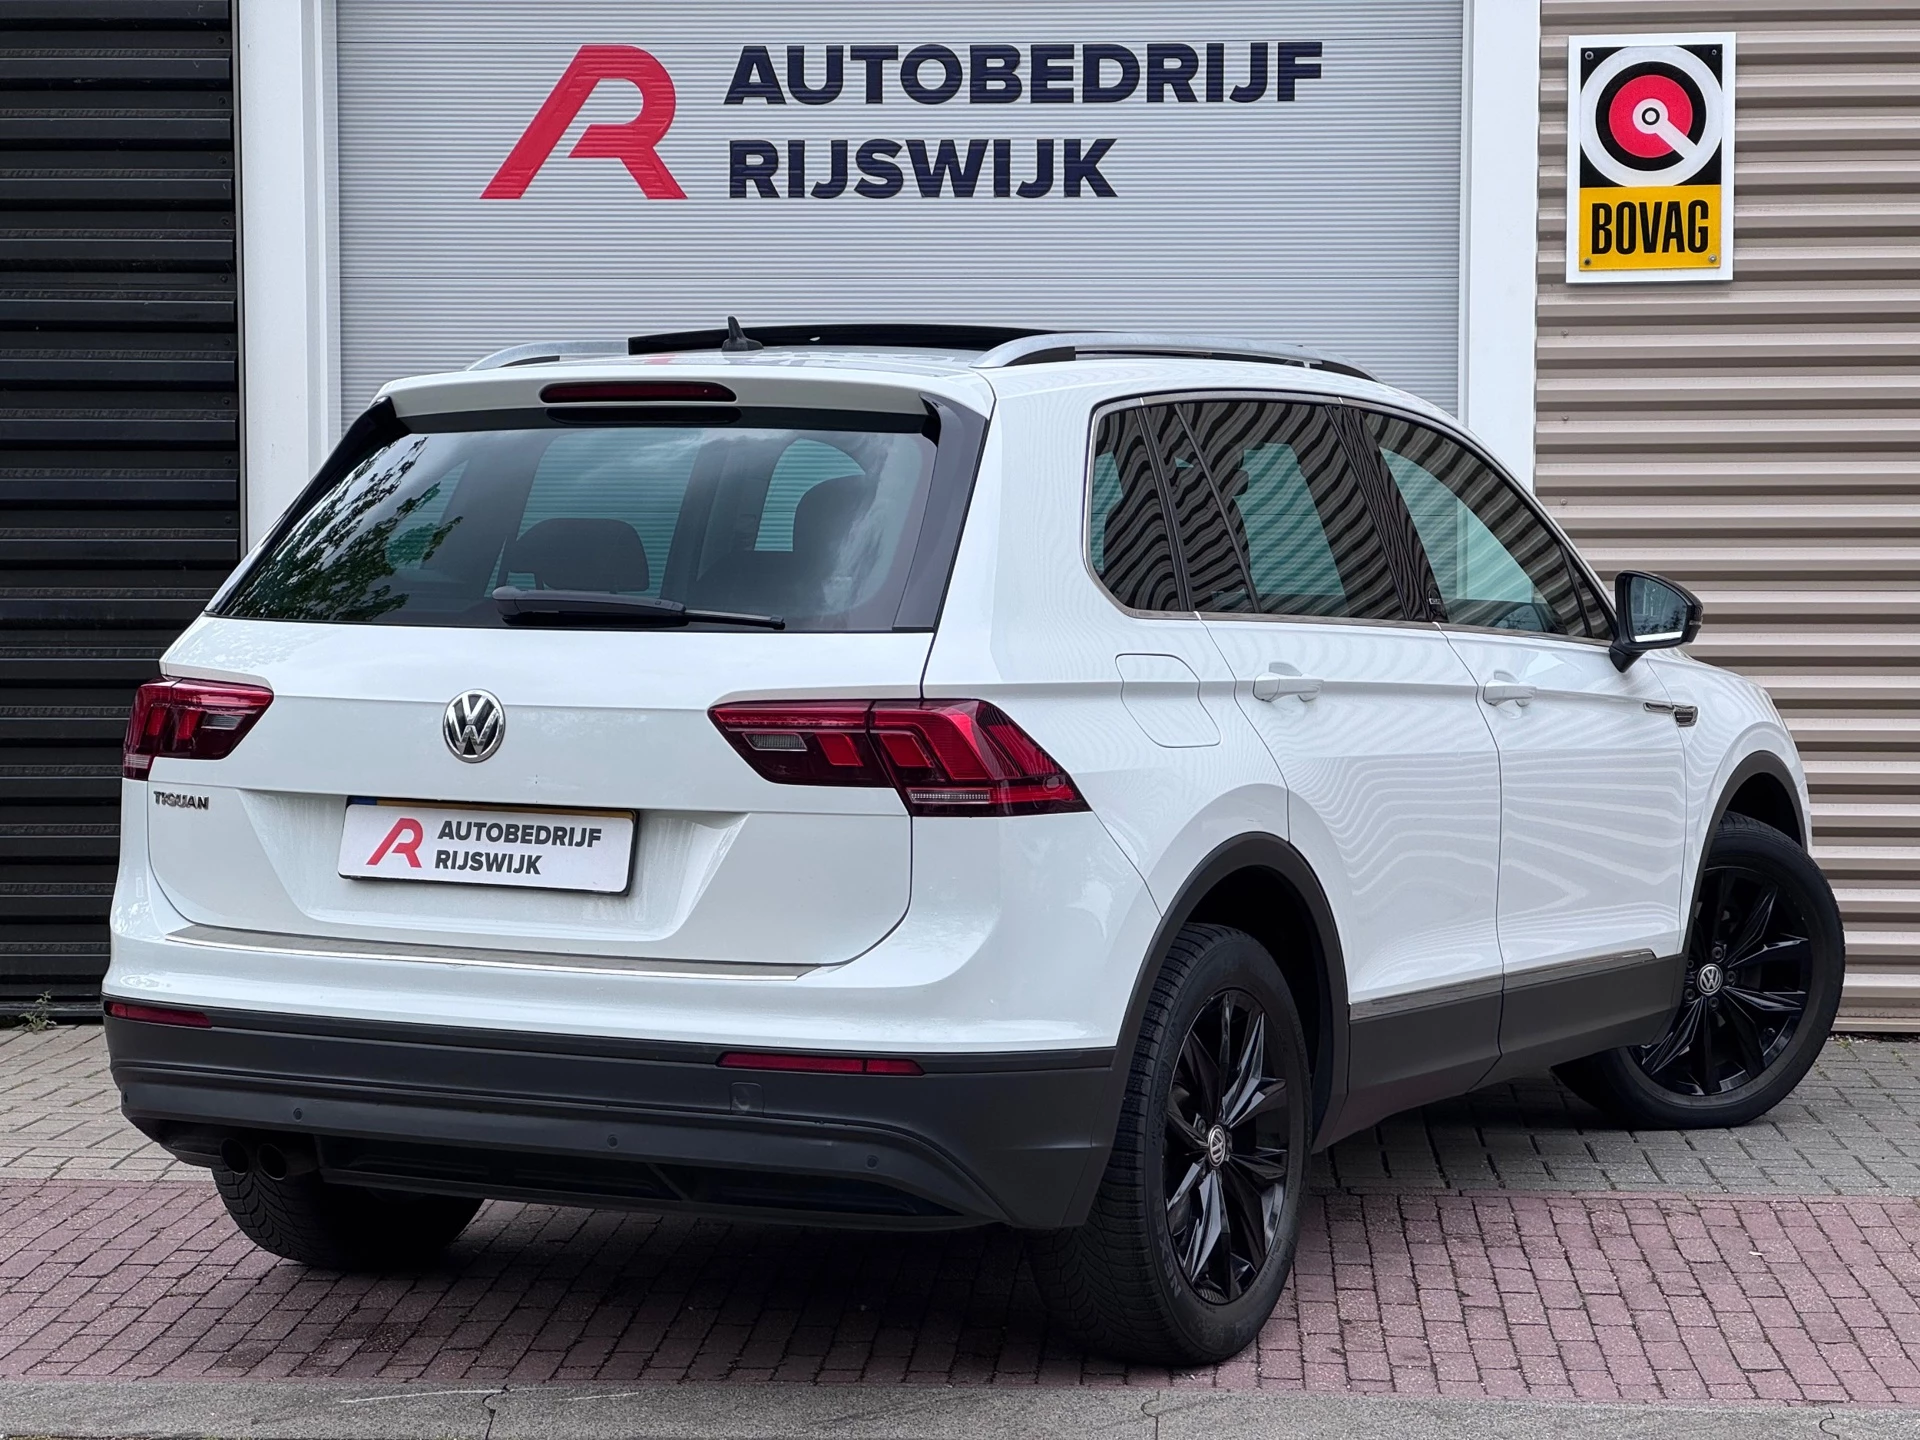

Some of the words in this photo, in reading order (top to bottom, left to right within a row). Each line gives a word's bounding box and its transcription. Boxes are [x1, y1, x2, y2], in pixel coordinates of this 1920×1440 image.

[724, 42, 1322, 105] AUTOBEDRIJF
[729, 138, 1118, 199] RIJSWIJK
[1591, 200, 1709, 255] BOVAG
[153, 790, 210, 811] TIGUAN
[437, 820, 602, 848] AUTOBEDRIJF
[434, 849, 542, 875] RIJSWIJK
